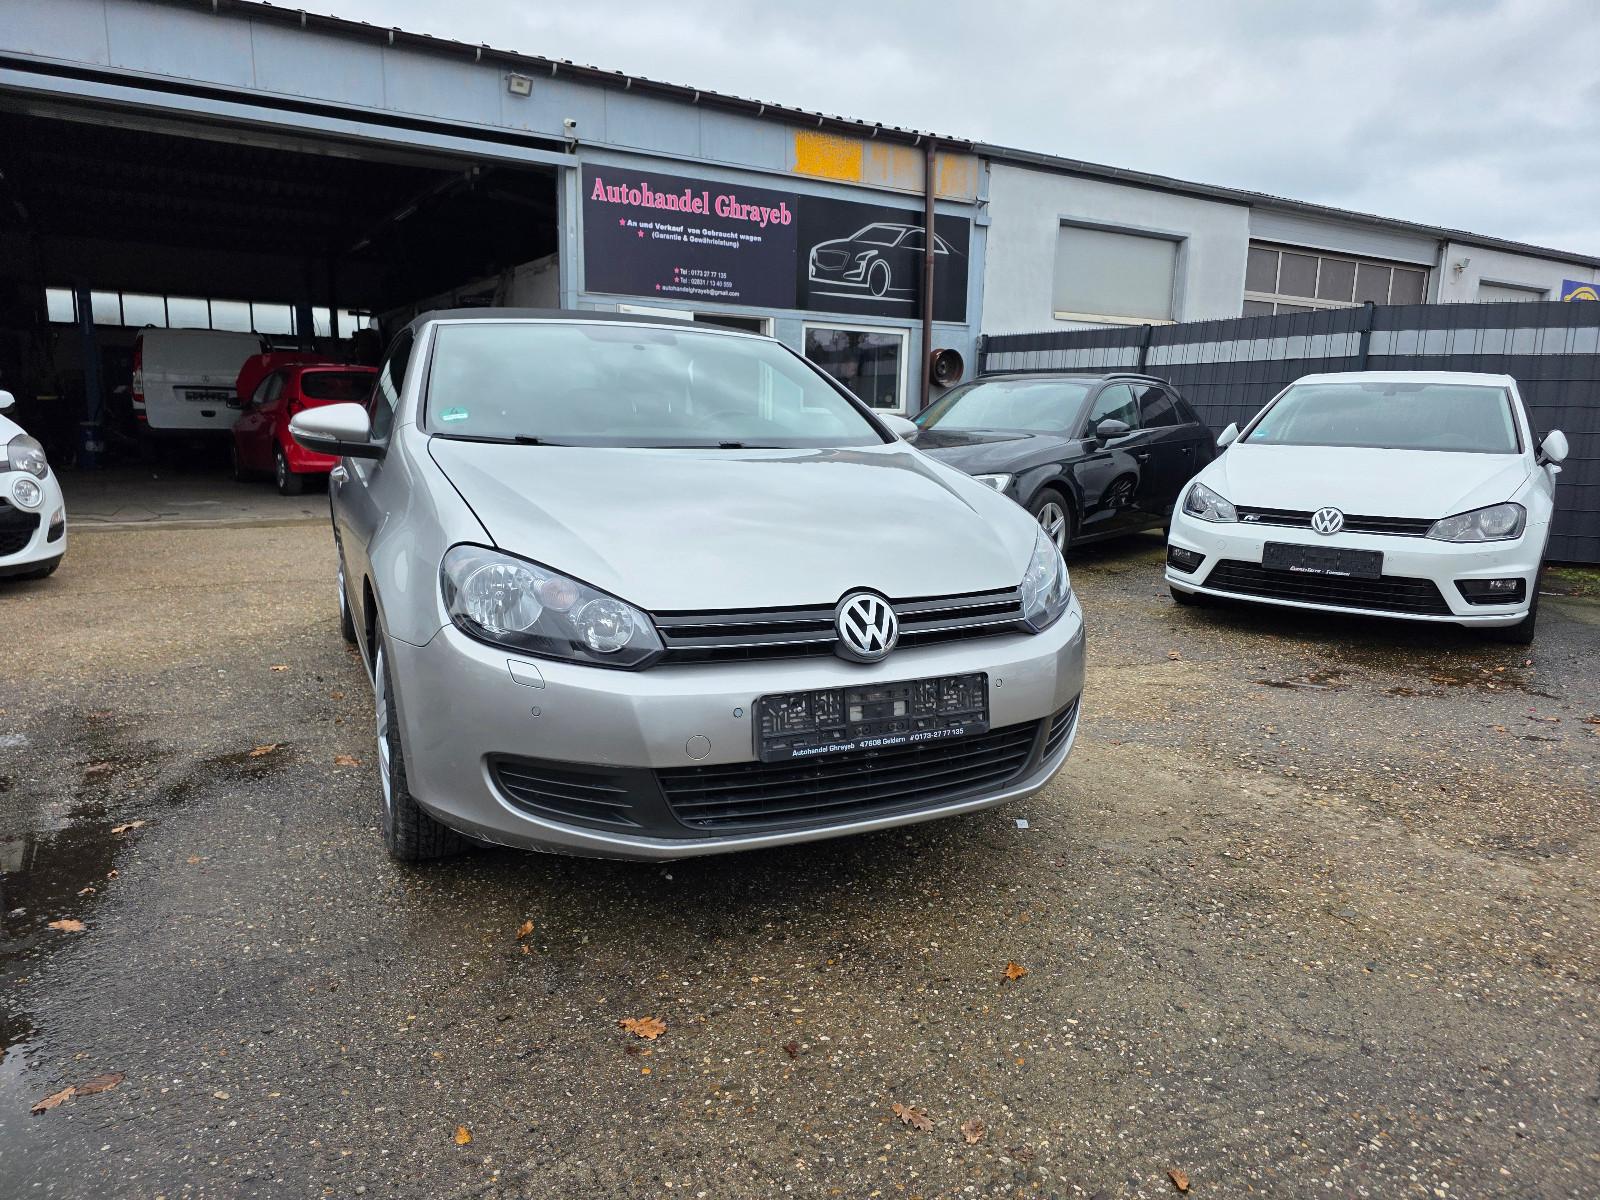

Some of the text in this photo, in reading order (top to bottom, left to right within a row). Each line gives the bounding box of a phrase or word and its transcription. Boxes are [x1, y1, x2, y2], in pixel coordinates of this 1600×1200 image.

[591, 178, 791, 227] Autohandel Ghrayeb
[627, 219, 762, 243] An und Verkauf von Gebraucht wagen
[651, 231, 740, 249] (Garantie & Gewährleistung)
[691, 269, 703, 277] 0173
[792, 746, 829, 757] Autohandel
[829, 742, 855, 751] Ghrayeb
[882, 736, 906, 745] Geldern
[951, 727, 964, 736] 135
